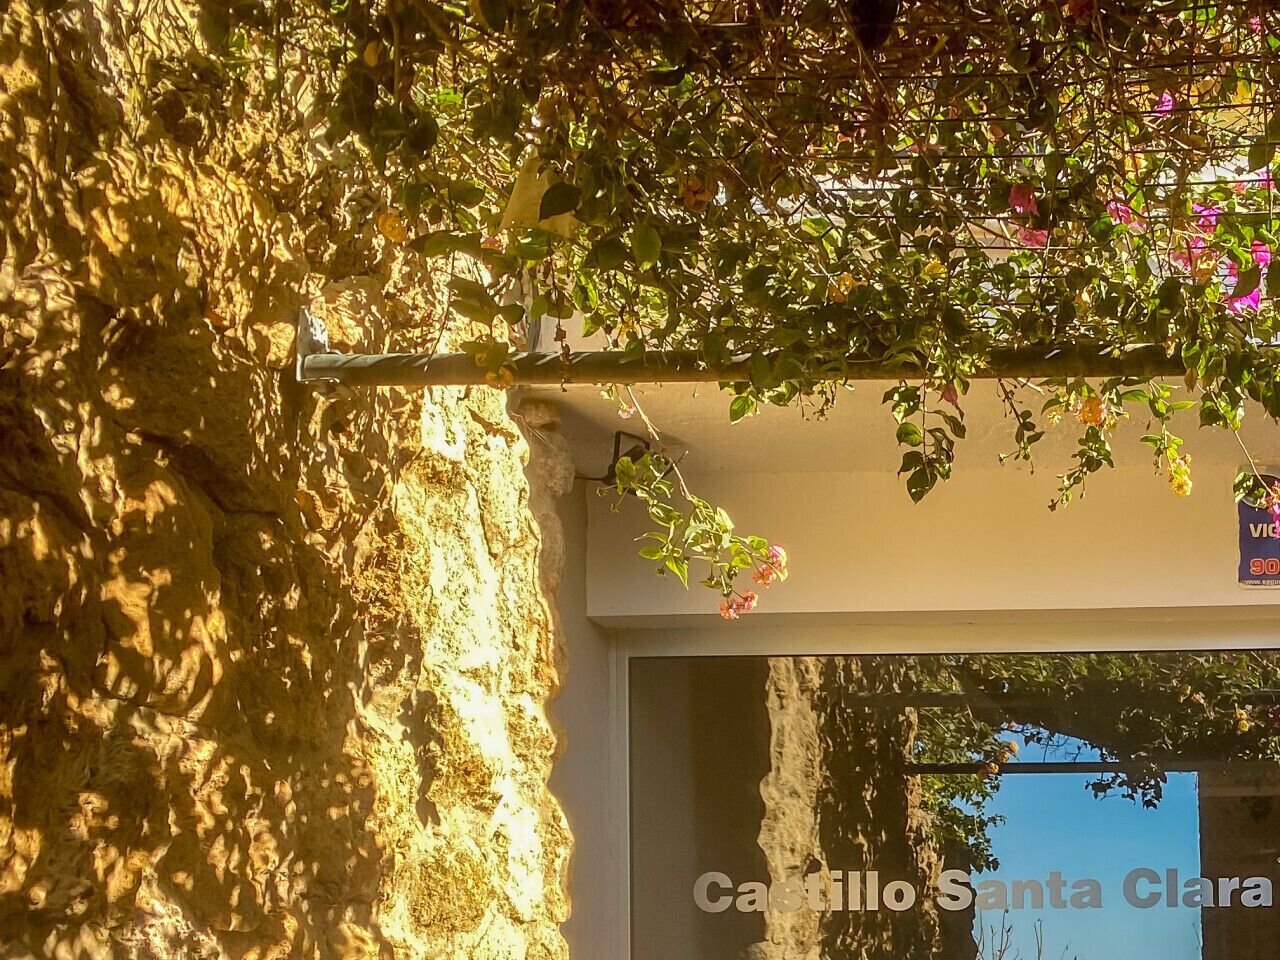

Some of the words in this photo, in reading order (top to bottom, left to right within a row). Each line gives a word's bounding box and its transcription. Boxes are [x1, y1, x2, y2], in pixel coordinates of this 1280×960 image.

[693, 870, 916, 914] Castillo
[937, 870, 1103, 913] Santa
[1121, 868, 1274, 910] Clara
